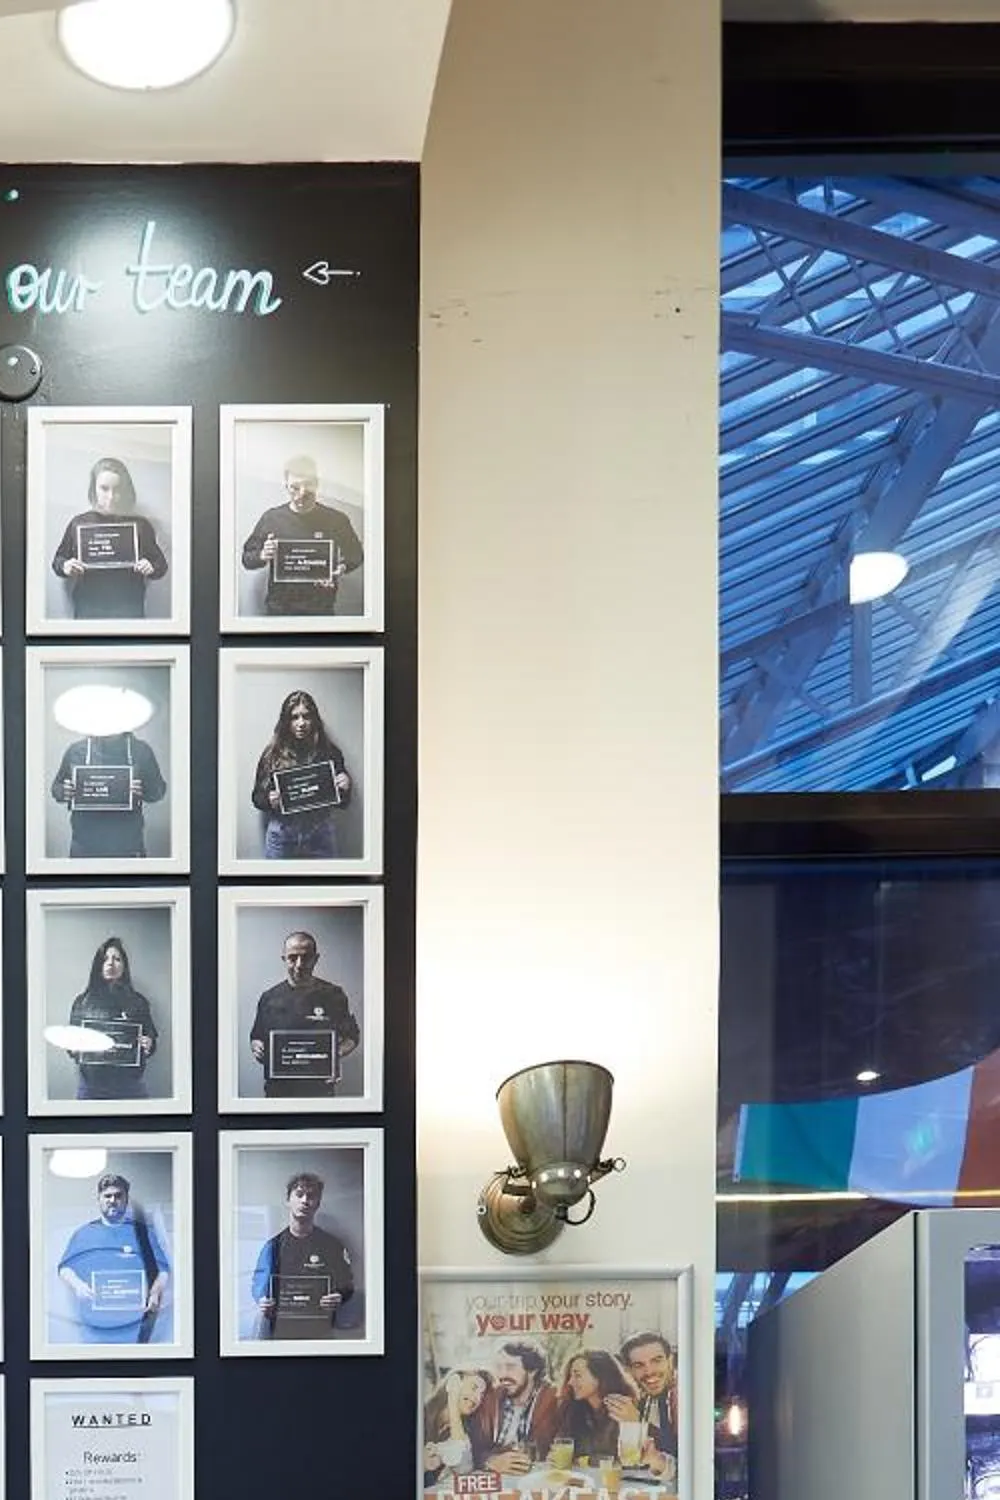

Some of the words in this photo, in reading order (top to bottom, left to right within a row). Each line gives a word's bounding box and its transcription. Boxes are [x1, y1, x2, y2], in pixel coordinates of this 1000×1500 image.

[7, 263, 101, 314] our
[126, 220, 284, 316] team
[541, 1294, 580, 1312] your
[585, 1290, 633, 1311] story.
[476, 1313, 536, 1337] your
[541, 1312, 594, 1334] way.
[71, 1412, 152, 1427] WANTED
[457, 1475, 498, 1493] FREE
